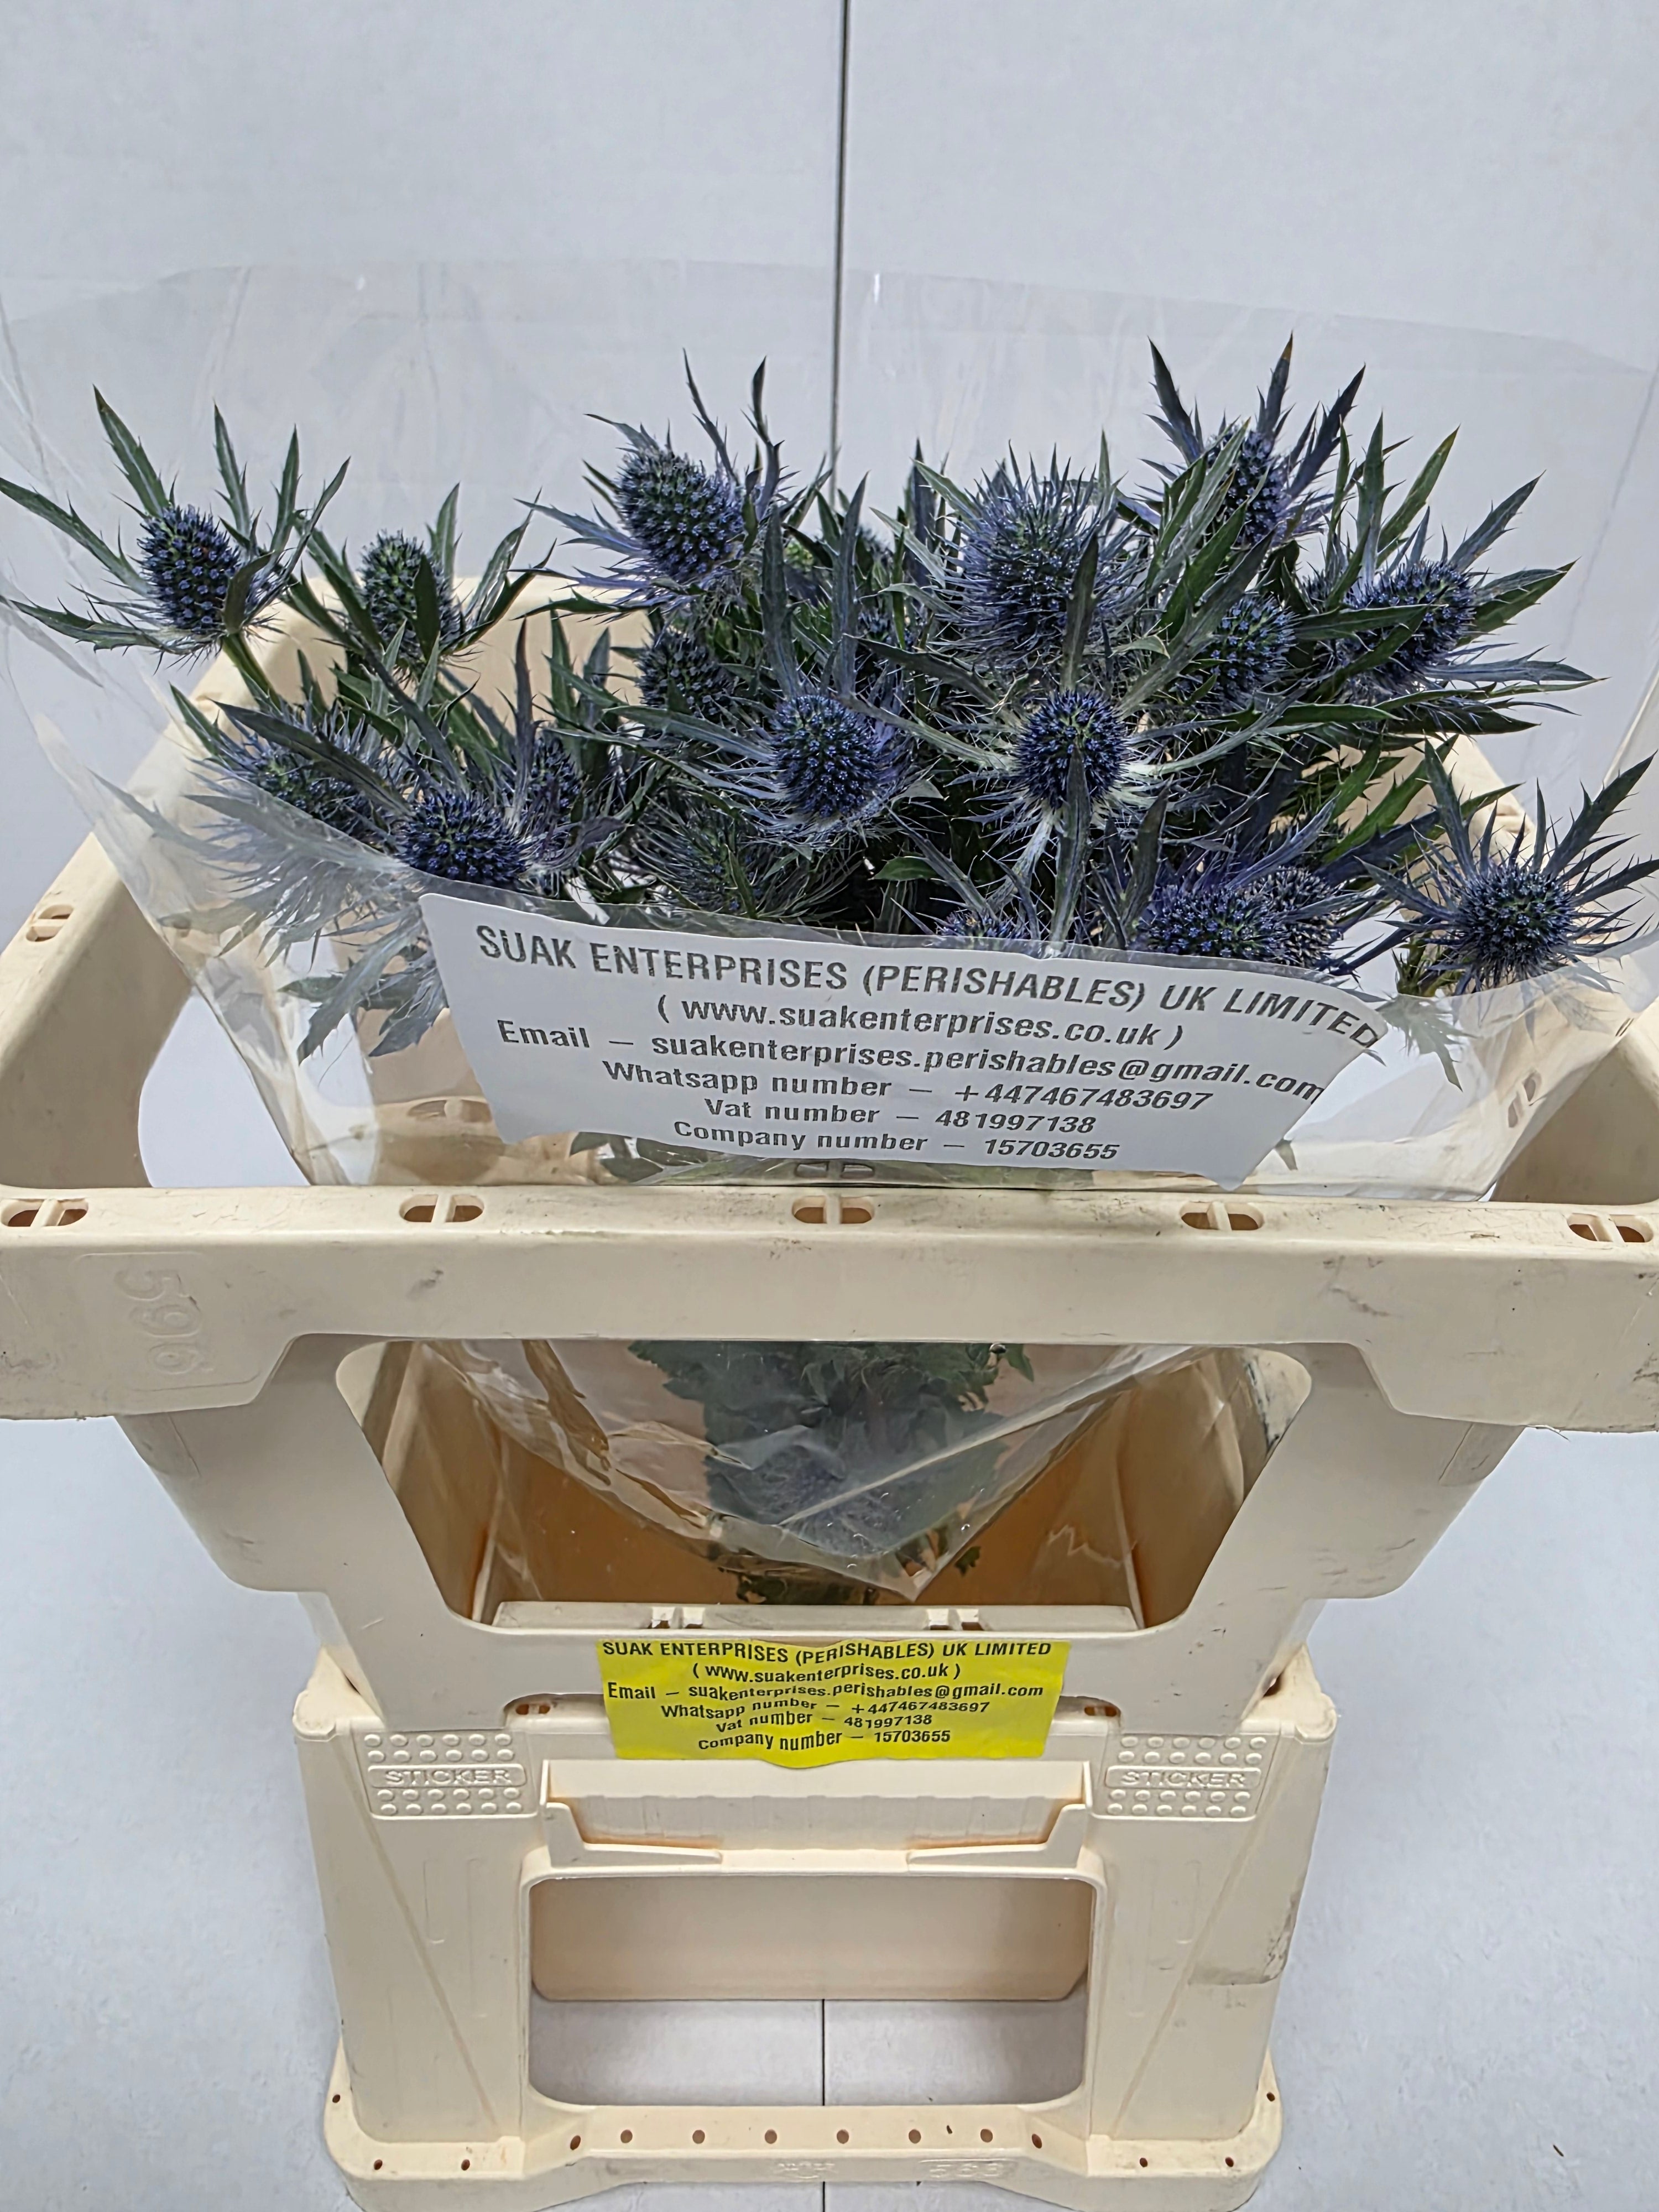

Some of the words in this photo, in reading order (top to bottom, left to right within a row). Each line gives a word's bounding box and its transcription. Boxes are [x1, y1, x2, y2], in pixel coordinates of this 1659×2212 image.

[477, 926, 576, 968] SUAK
[589, 943, 846, 989] ENTERPRISES
[863, 966, 1144, 1012] (PERISHABLES)
[1160, 985, 1217, 1011] UK
[1223, 989, 1378, 1048] LIMITED
[681, 1001, 1161, 1045] www.suakenterprises.co.uk
[498, 1020, 589, 1047] Email
[652, 1035, 1326, 1104] suakenterprises.perishables@gmail.com
[602, 1061, 757, 1094] Whatsapp
[773, 1077, 891, 1096] number
[955, 1084, 1213, 1109] +447467483697
[705, 1099, 751, 1118] Vat
[766, 1105, 880, 1123] number
[935, 1110, 1096, 1133] 481997138
[675, 1121, 806, 1150] Company
[818, 1134, 928, 1150] number
[985, 1139, 1120, 1159] 15703655
[603, 1642, 653, 1655] SUAK
[660, 1643, 788, 1662] ENTERPRISES
[796, 1642, 934, 1666] (PERISHABLES)
[943, 1643, 967, 1656] UK
[975, 1643, 1051, 1655] LIMITED
[705, 1663, 948, 1682] www.suakenterprises.co.uk
[608, 1682, 655, 1699] Email
[688, 1683, 1043, 1700] suakenterprises.perishables@gmail.com
[661, 1705, 744, 1719] Whatsapp
[753, 1698, 817, 1710] number
[852, 1702, 989, 1714] +447467483697
[716, 1719, 742, 1732] Vat
[750, 1711, 812, 1725] number
[844, 1715, 932, 1729] 481997138
[699, 1734, 773, 1749] Company
[780, 1731, 842, 1750] number
[874, 1730, 950, 1742] 15703655
[385, 1770, 512, 1786] STICKER
[1121, 1771, 1246, 1787] STICKER
